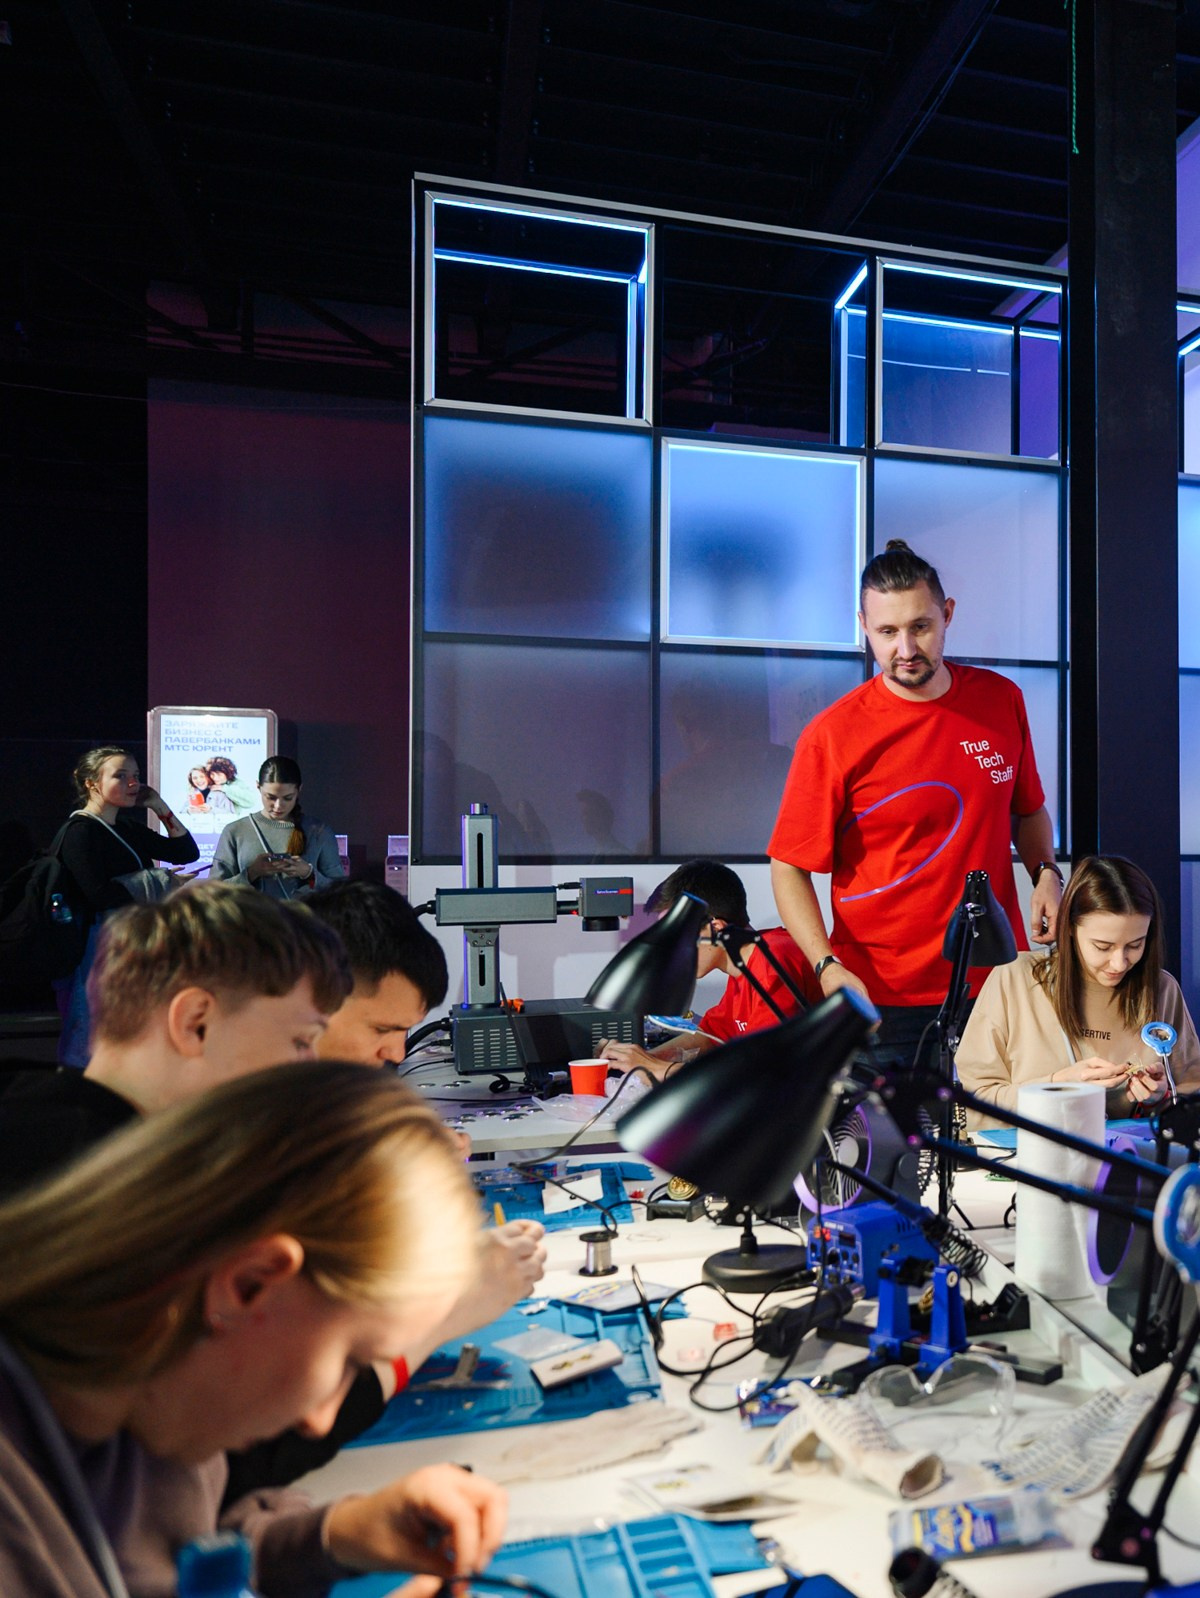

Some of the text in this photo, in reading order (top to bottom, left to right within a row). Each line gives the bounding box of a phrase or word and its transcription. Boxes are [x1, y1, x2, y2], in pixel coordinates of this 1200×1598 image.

[165, 728, 211, 736] БИЗНЕС
[165, 736, 261, 745] ПАВЕРБАНКАМИ
[165, 744, 234, 753] МТС ЮРЕНТ
[960, 740, 990, 755] True
[974, 751, 1005, 769] Tech
[990, 765, 1013, 784] Staff
